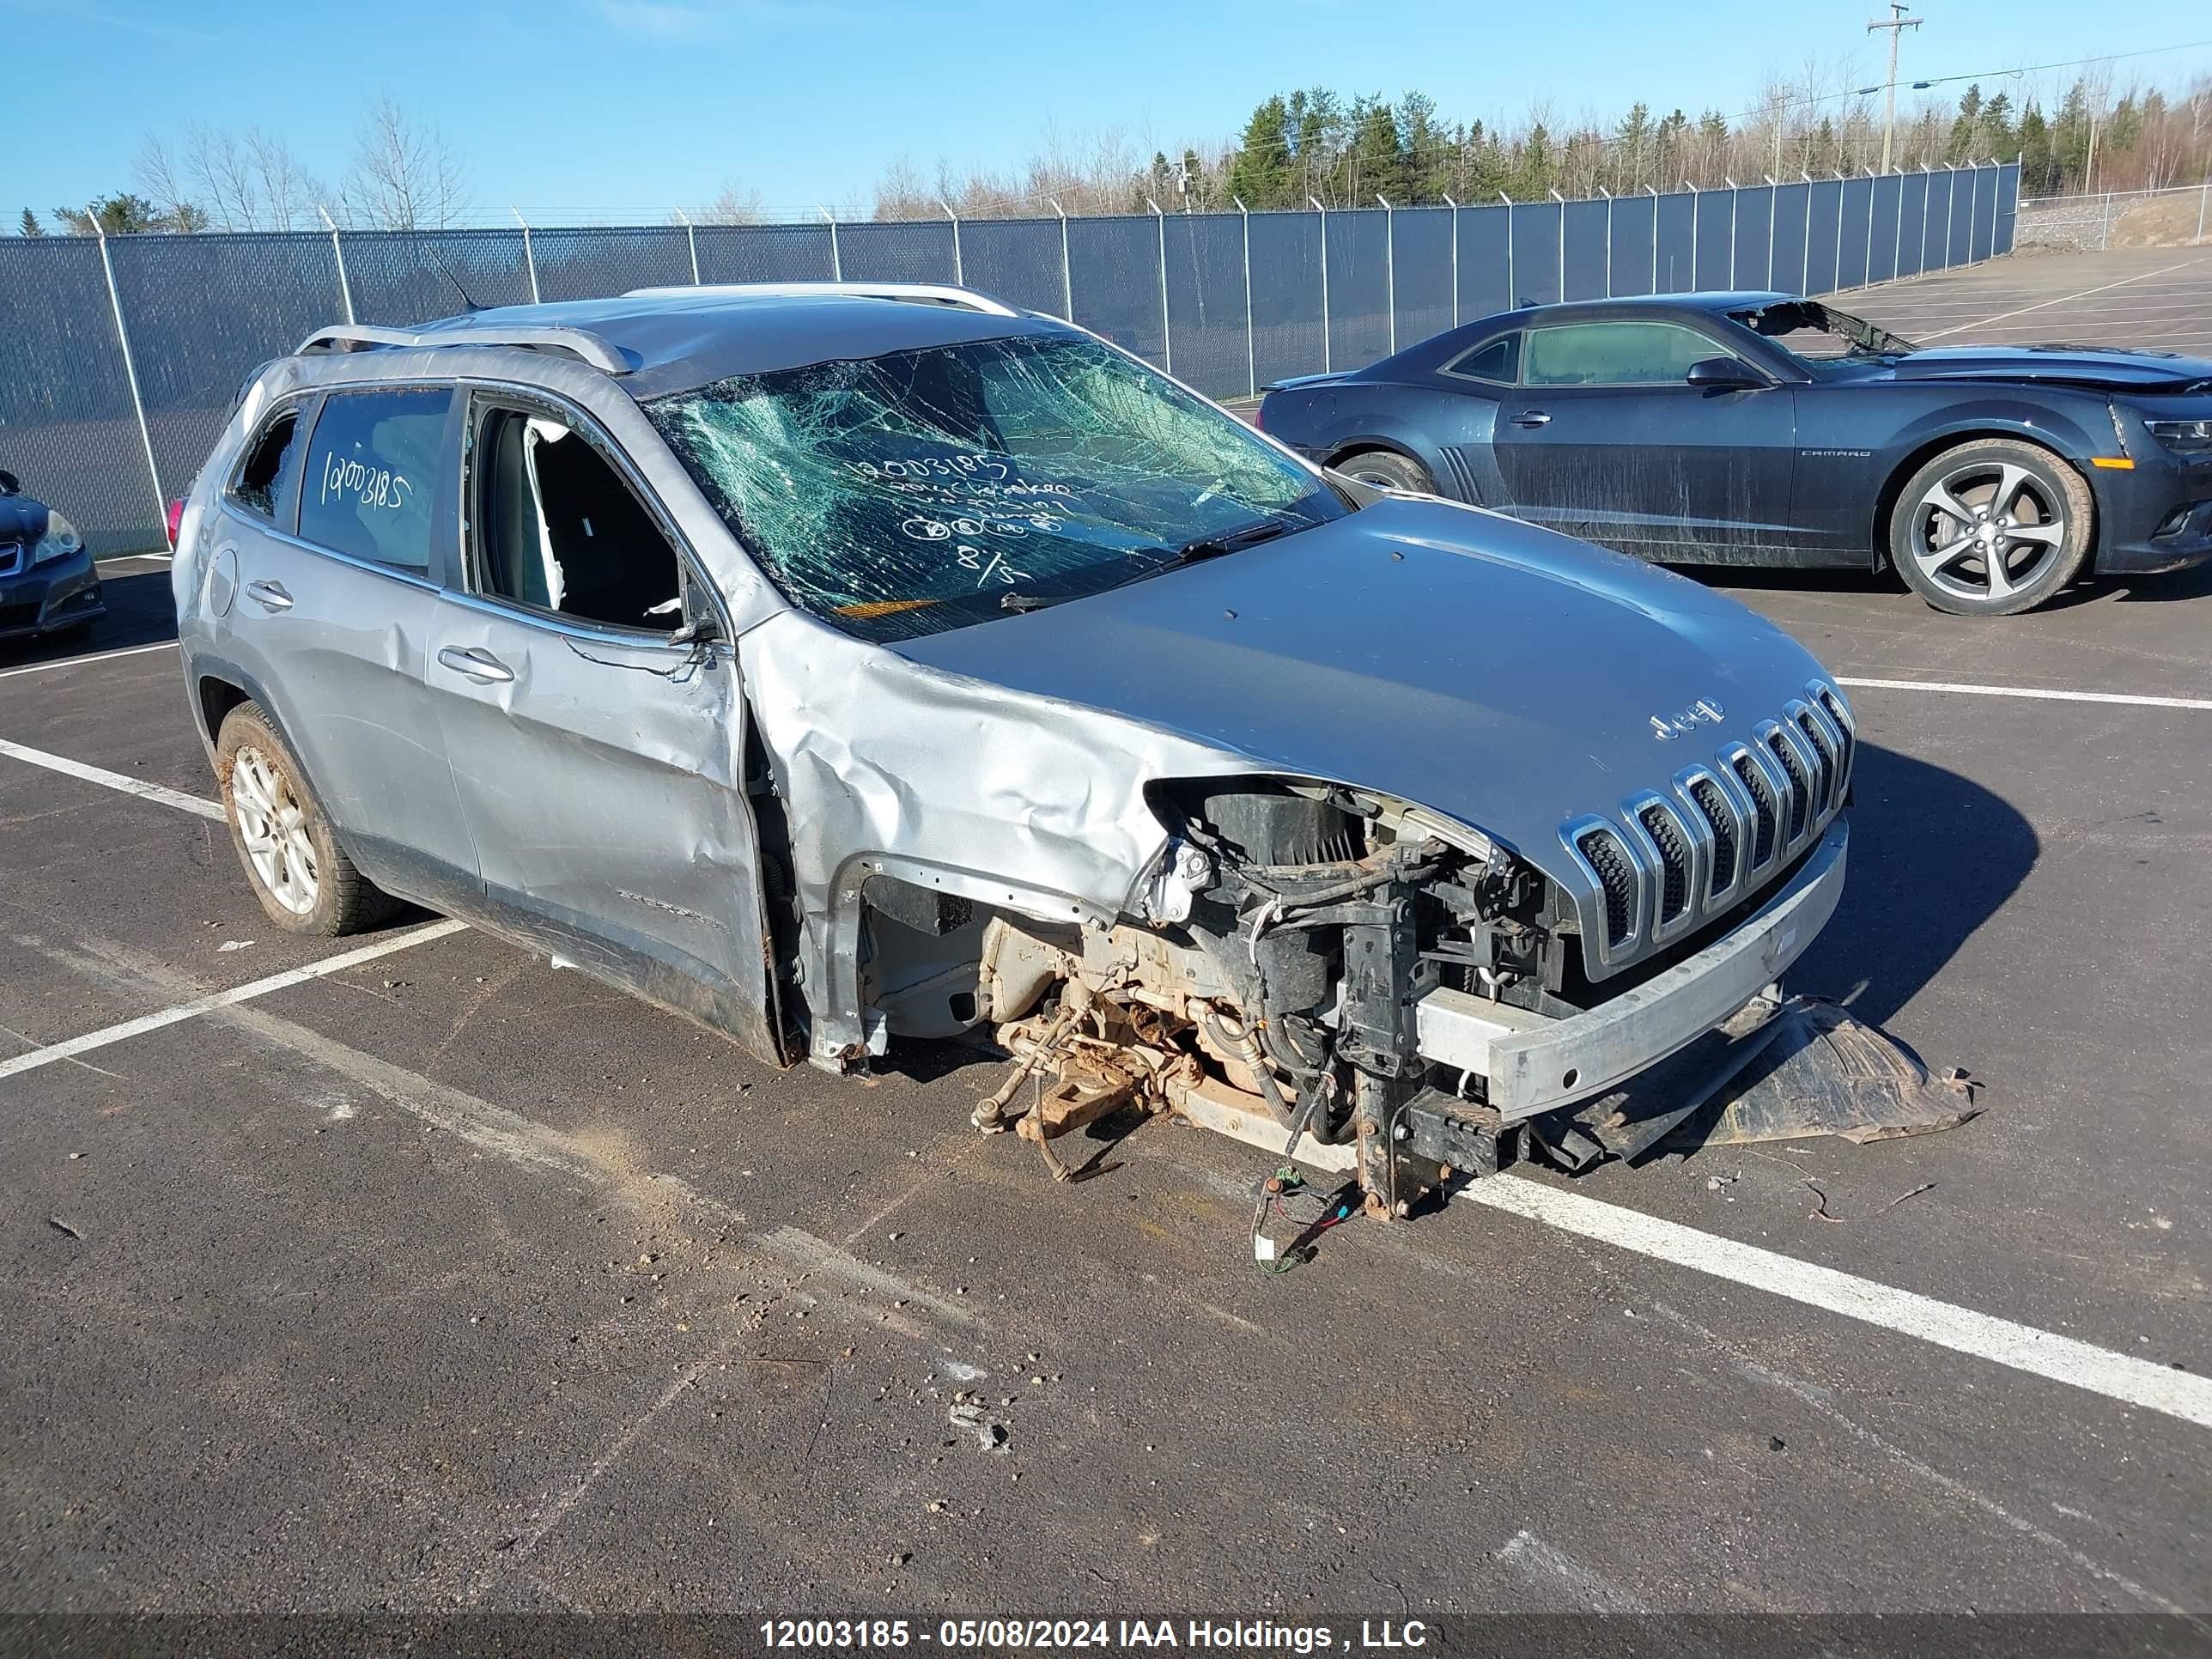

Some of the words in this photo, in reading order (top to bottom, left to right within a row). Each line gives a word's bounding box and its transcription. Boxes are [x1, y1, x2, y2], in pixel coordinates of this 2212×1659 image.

[321, 451, 413, 512] 12003185
[843, 454, 1007, 481] 12003185
[1649, 696, 1725, 741] Jeep
